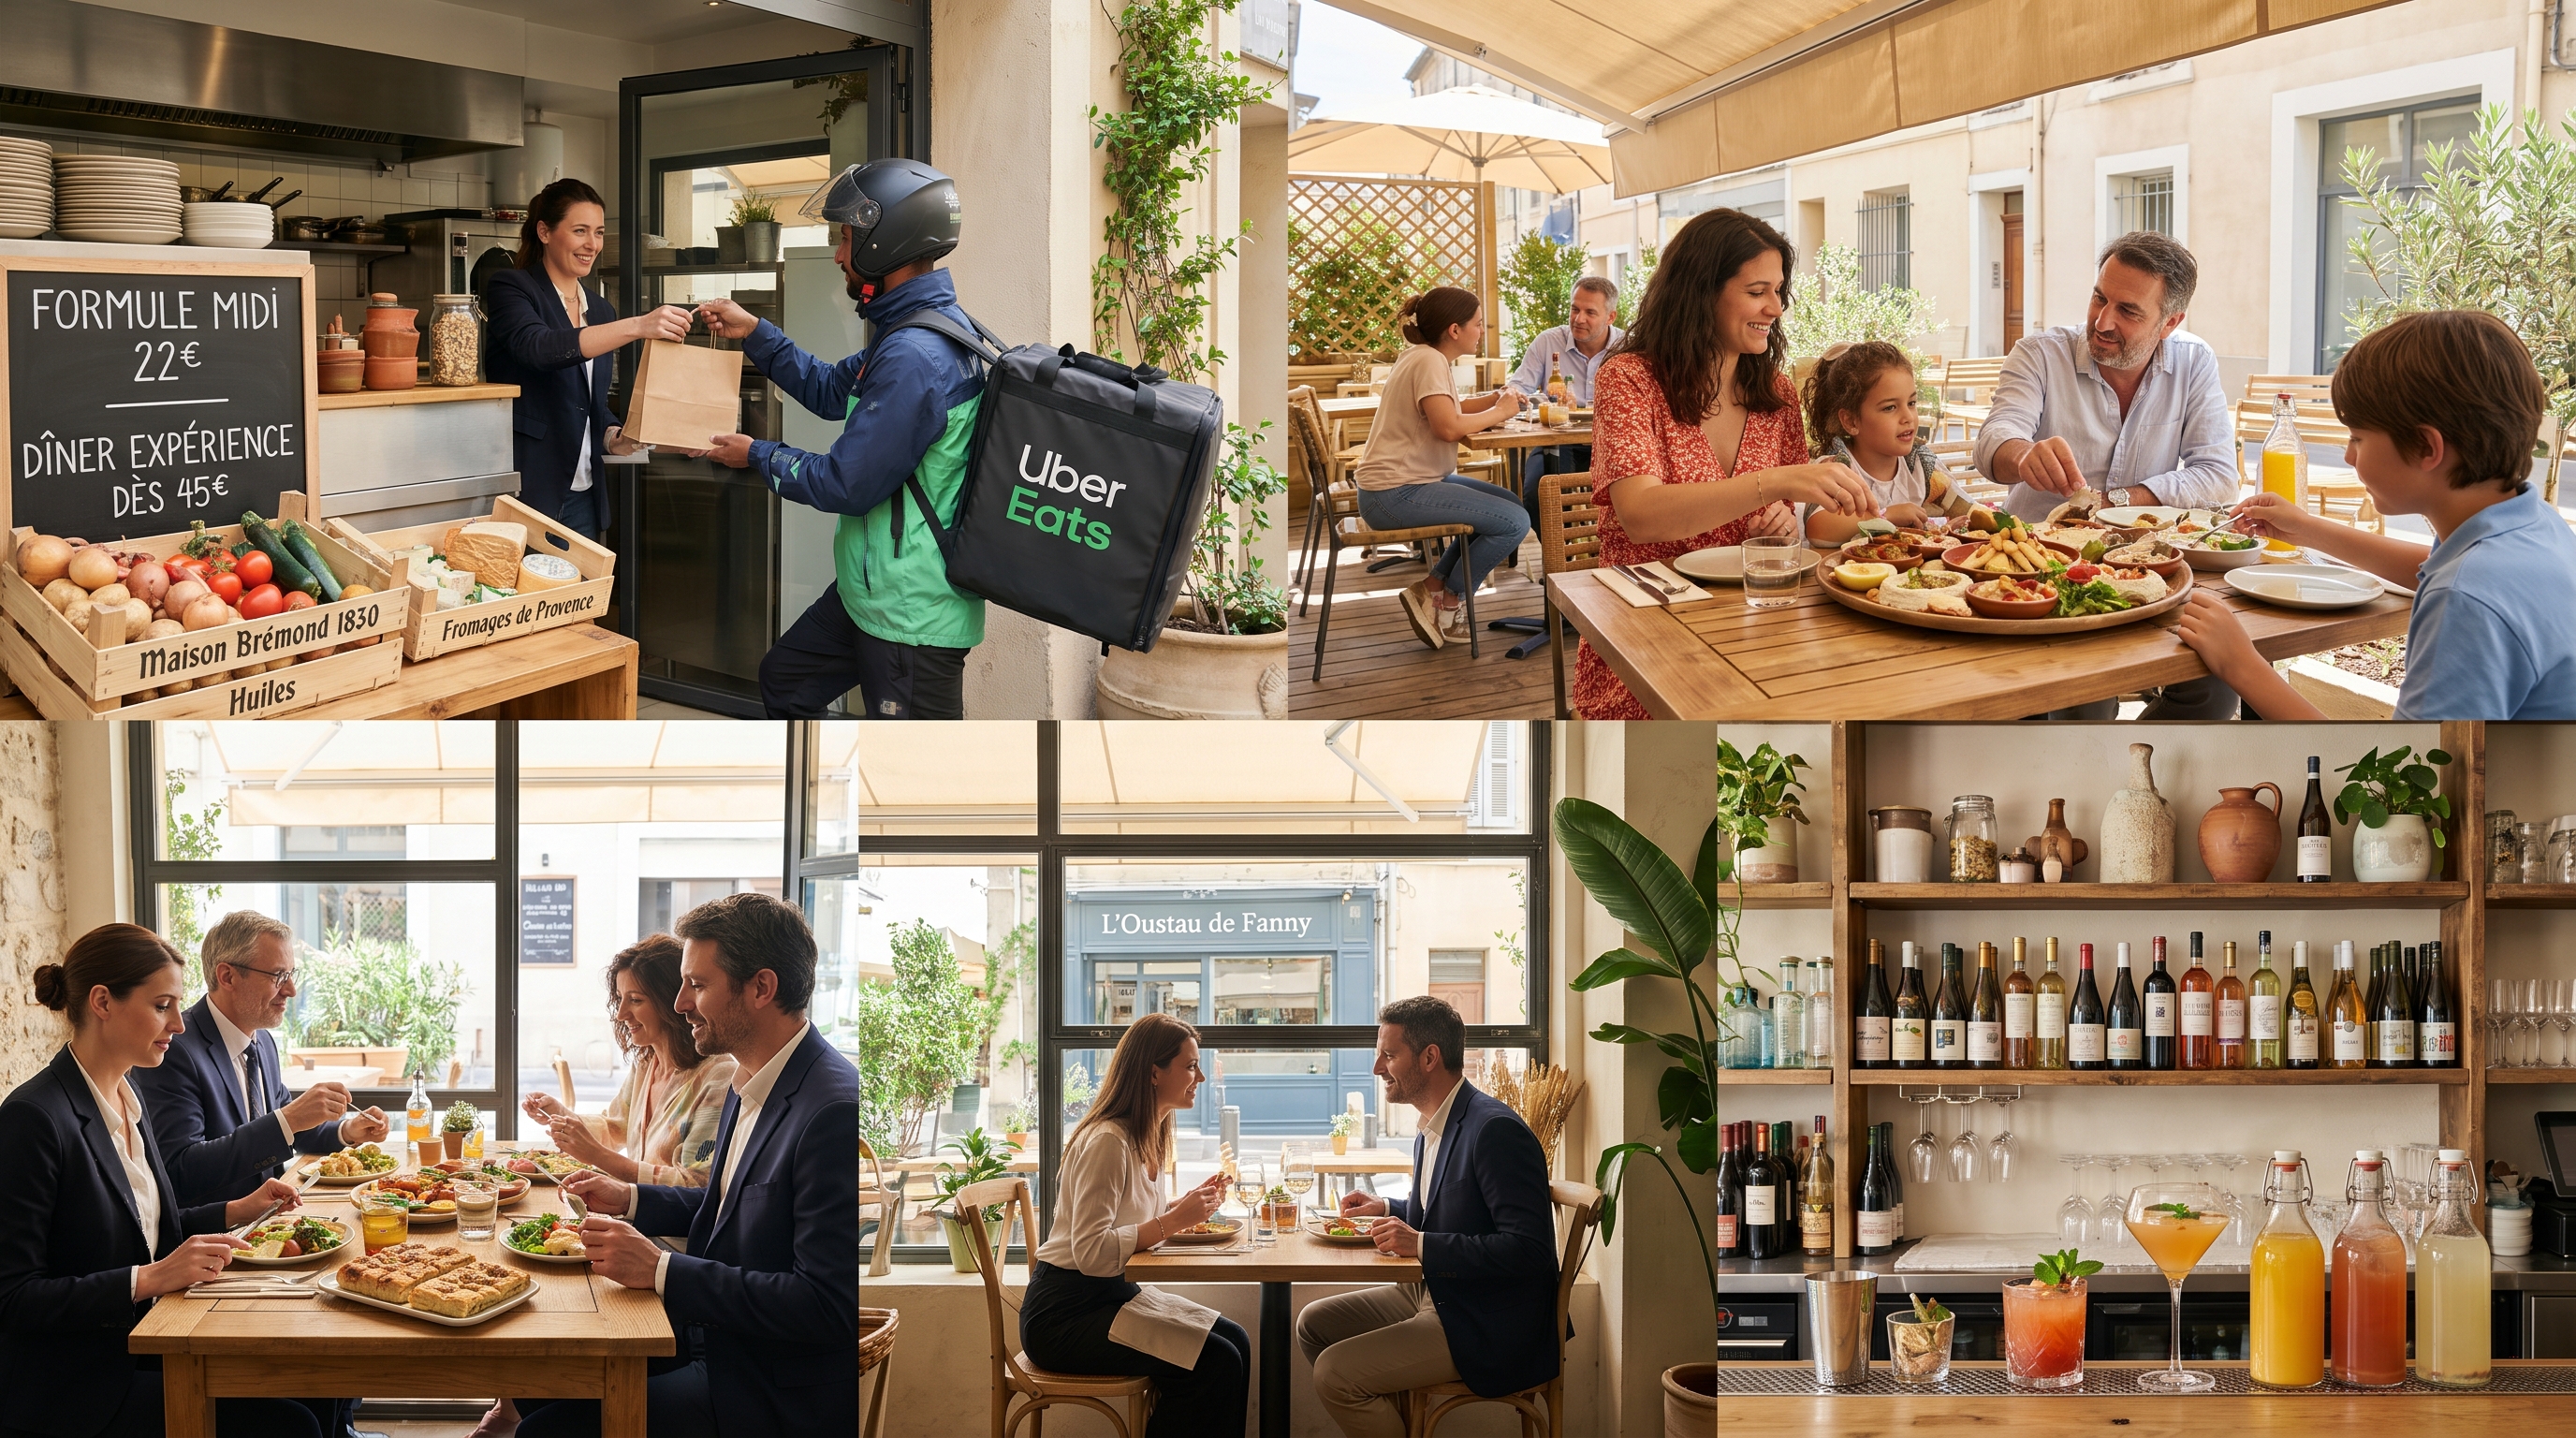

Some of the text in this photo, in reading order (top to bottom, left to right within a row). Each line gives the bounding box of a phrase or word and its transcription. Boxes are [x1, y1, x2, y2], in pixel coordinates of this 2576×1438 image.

[33, 288, 198, 330] FORMULE
[133, 341, 202, 383] 22€
[22, 418, 295, 479] DÎNER EXPÉRIENCE
[112, 473, 229, 519] DÈS 45€
[1018, 443, 1127, 508] Uber
[1005, 484, 1112, 550] Eats
[139, 604, 379, 680] Maison Brémond 1830
[442, 594, 593, 643] Fromages de Provence
[229, 679, 296, 717] Huiles
[1101, 911, 1312, 938] L'Oustau de Fanny
